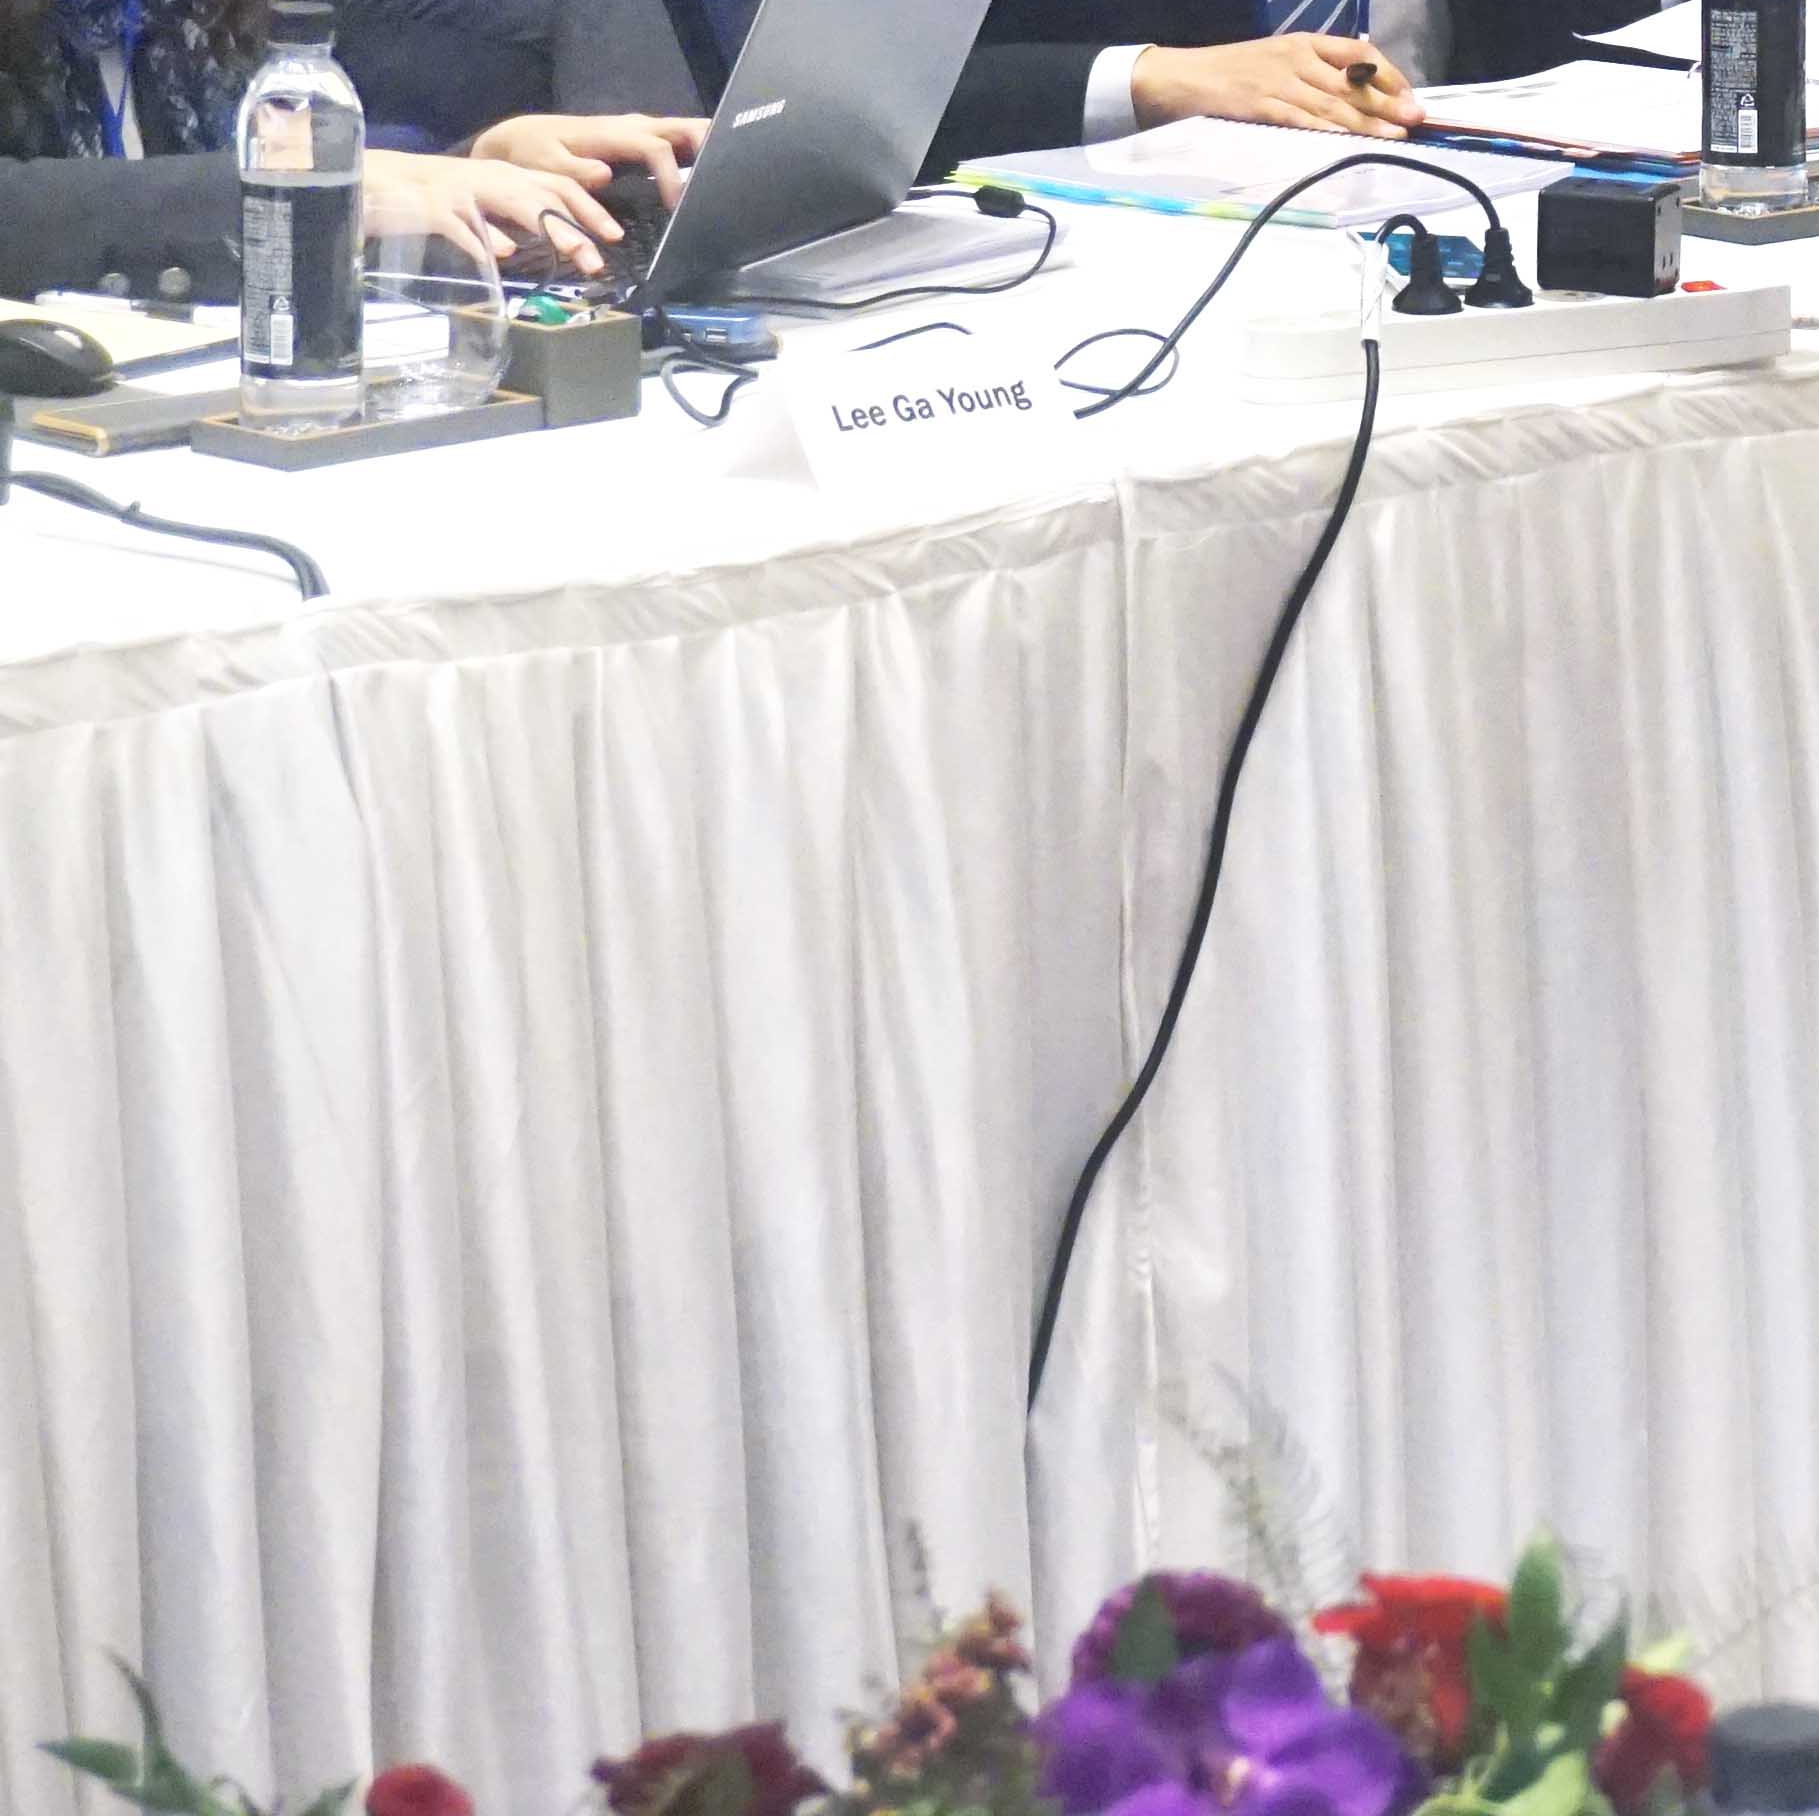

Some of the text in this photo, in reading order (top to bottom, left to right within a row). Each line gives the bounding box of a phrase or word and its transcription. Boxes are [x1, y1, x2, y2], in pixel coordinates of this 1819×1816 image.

[732, 98, 787, 129] SAMSUNG
[831, 379, 1033, 432] Lee Ga Young
